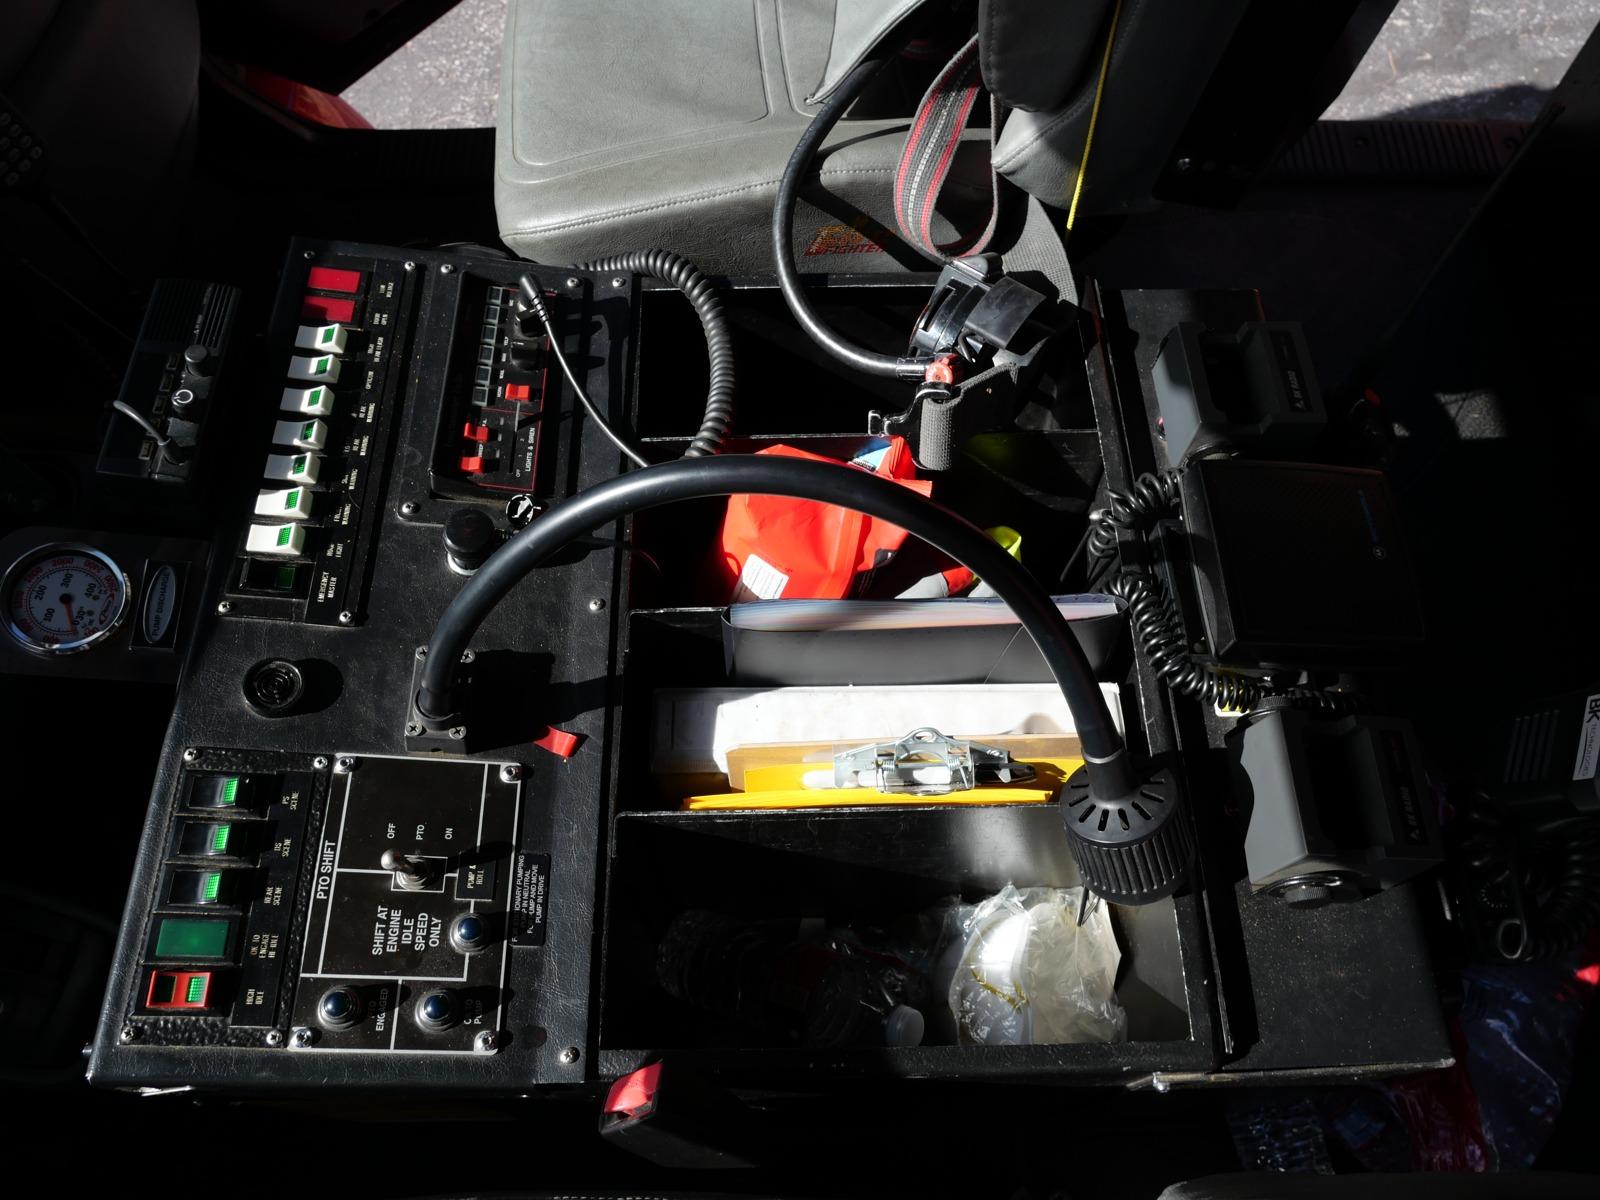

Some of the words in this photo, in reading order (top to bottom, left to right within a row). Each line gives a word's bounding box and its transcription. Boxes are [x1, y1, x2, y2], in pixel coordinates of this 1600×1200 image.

[527, 427, 536, 444] SIREN
[525, 451, 534, 472] LIGHTS
[34, 585, 46, 600] 200
[318, 571, 329, 603] EMERGENCY
[328, 576, 337, 599] MASTER
[1585, 699, 1600, 723] BK
[289, 791, 300, 811] SCENE
[386, 822, 397, 839] OFF
[415, 824, 426, 840] PTO
[444, 827, 454, 840] ON
[281, 837, 292, 858] SCENE
[320, 840, 337, 873] SHIFT
[466, 871, 476, 889] PUMP
[474, 868, 485, 885] ROLL
[517, 855, 525, 885] PUMPING
[316, 875, 332, 900] PTO
[537, 874, 545, 895] DRIVE
[376, 904, 388, 920] AT
[372, 921, 387, 956] SHIFT
[386, 908, 402, 952] ENGINE
[402, 918, 415, 944] IDLE
[414, 912, 429, 951] SPEED
[428, 916, 443, 947] ONLY
[258, 933, 270, 959] ENGAGE
[245, 988, 255, 1005] HIGH
[255, 990, 265, 1005] IDLE
[375, 988, 389, 1031] ENGAGED
